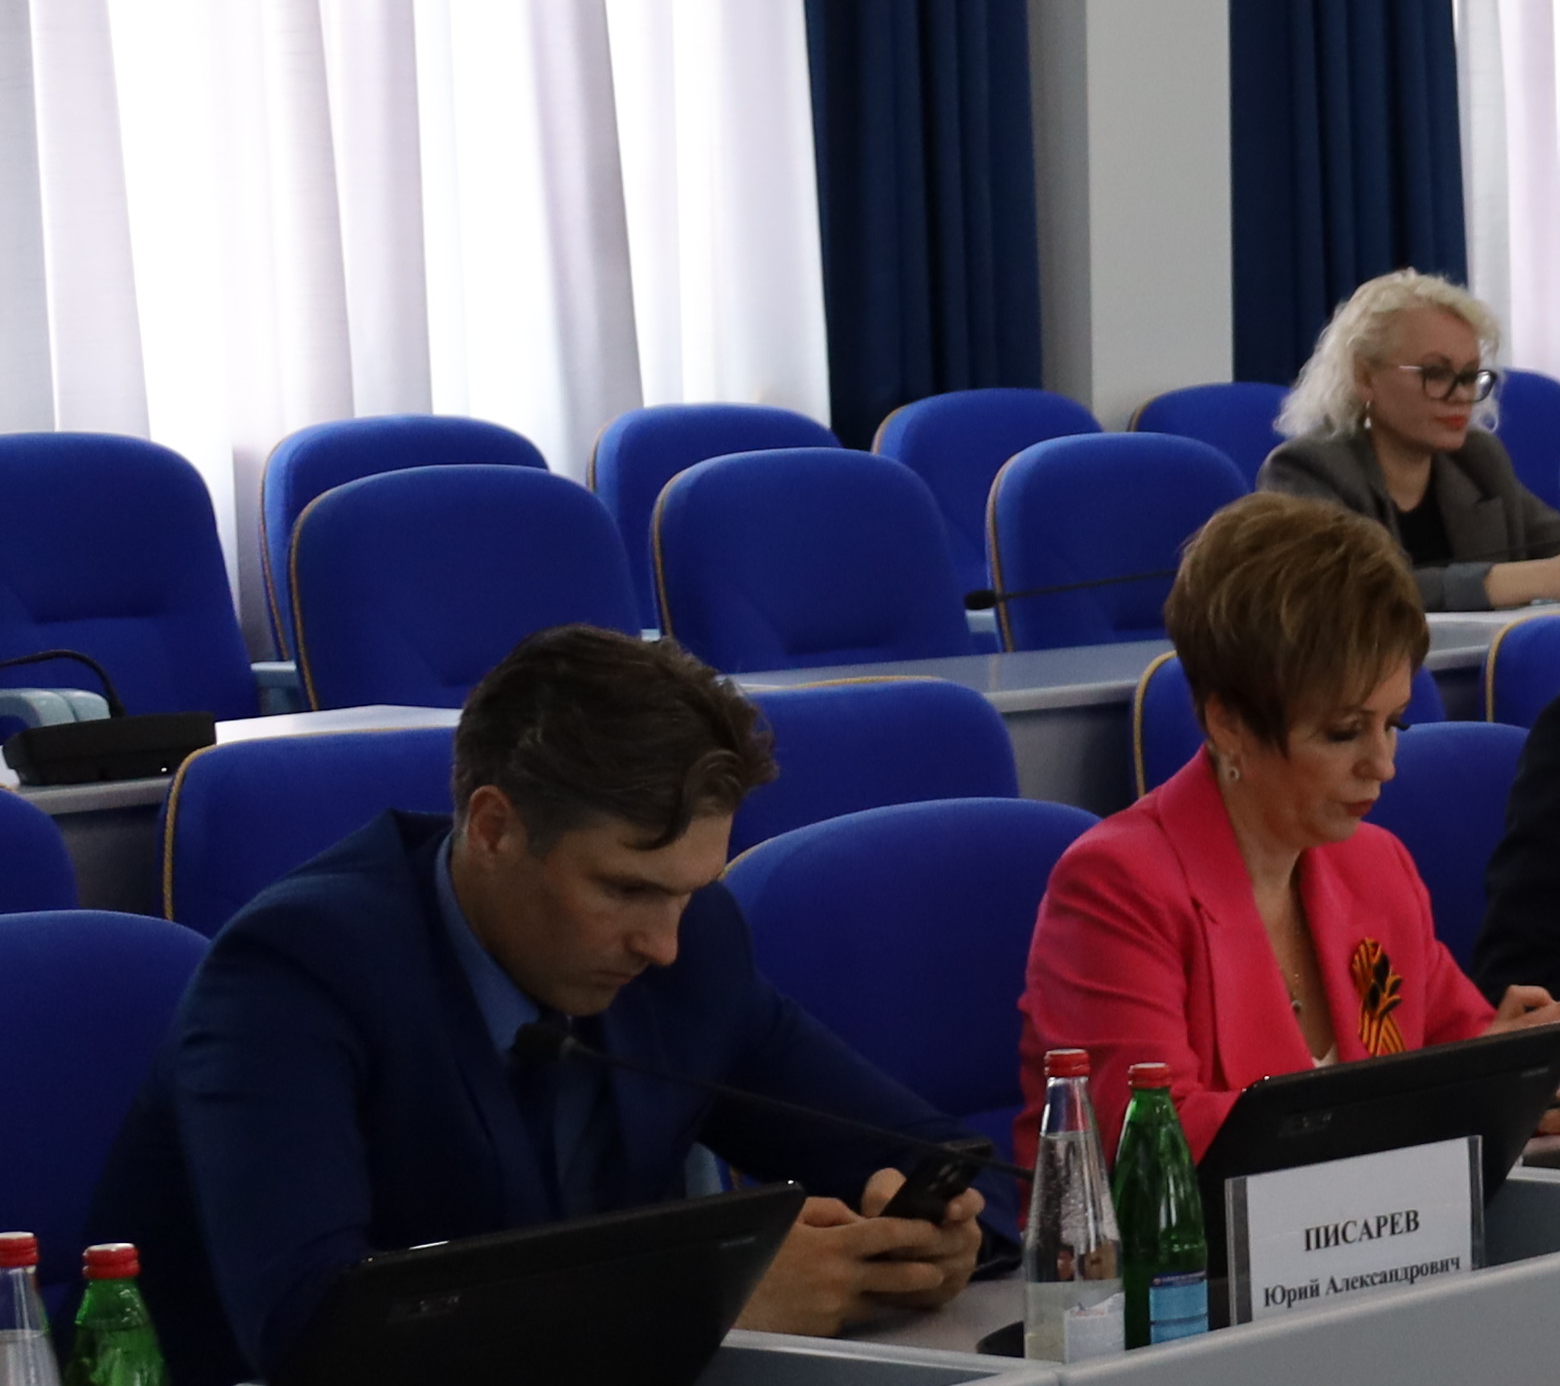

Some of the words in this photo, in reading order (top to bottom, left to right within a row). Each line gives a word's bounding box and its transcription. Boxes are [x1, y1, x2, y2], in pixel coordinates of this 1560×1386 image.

[1304, 1210, 1420, 1251] ПИСАРЕВ
[1264, 1279, 1320, 1308] Юрий
[1325, 1256, 1461, 1295] Александрович
